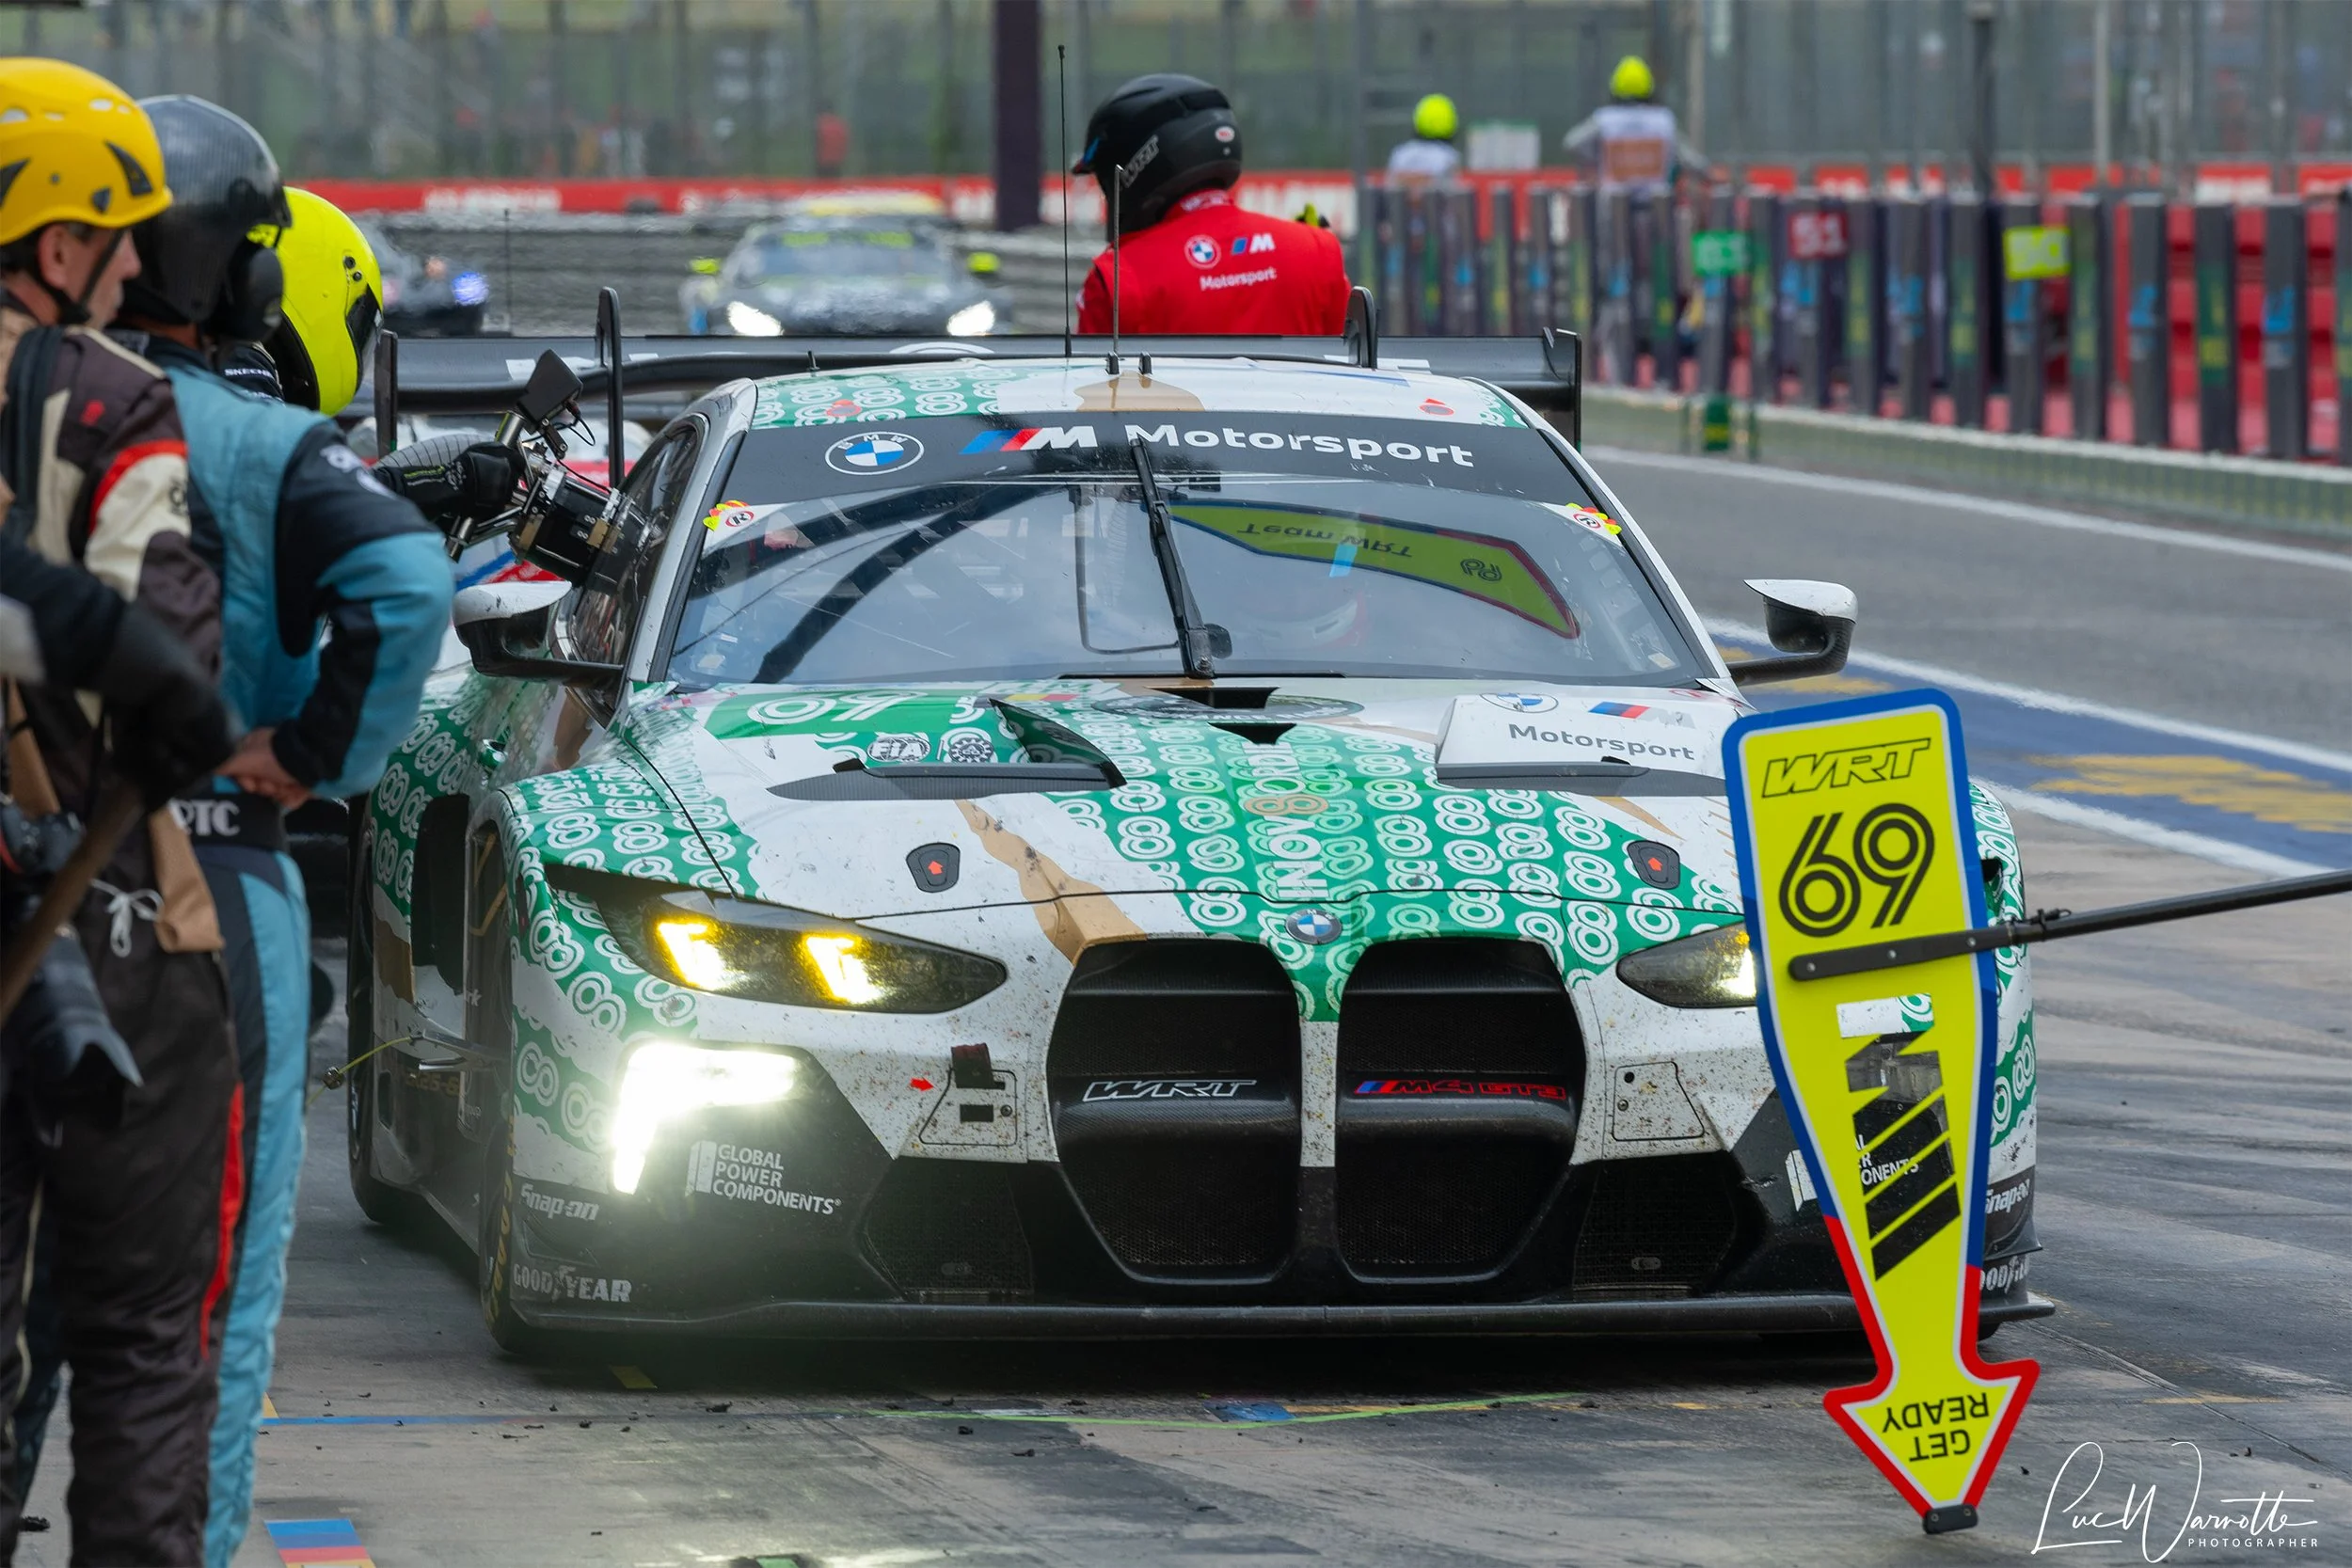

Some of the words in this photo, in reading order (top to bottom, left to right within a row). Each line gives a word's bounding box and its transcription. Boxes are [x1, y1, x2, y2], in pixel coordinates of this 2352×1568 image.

[1200, 267, 1277, 291] Motorsport
[1123, 424, 1475, 467] Motorsport
[1508, 723, 1695, 760] Motorsport
[1761, 737, 1931, 799] WRT
[1778, 802, 1935, 938] 69
[1082, 1079, 1257, 1102] WRT
[715, 1161, 783, 1188] POWER
[718, 1144, 785, 1170] GLOBAL
[520, 1182, 600, 1221] Snap-on
[513, 1263, 632, 1303] GOODYEAR
[1882, 1392, 1990, 1433] READY
[1908, 1429, 1971, 1463] GET
